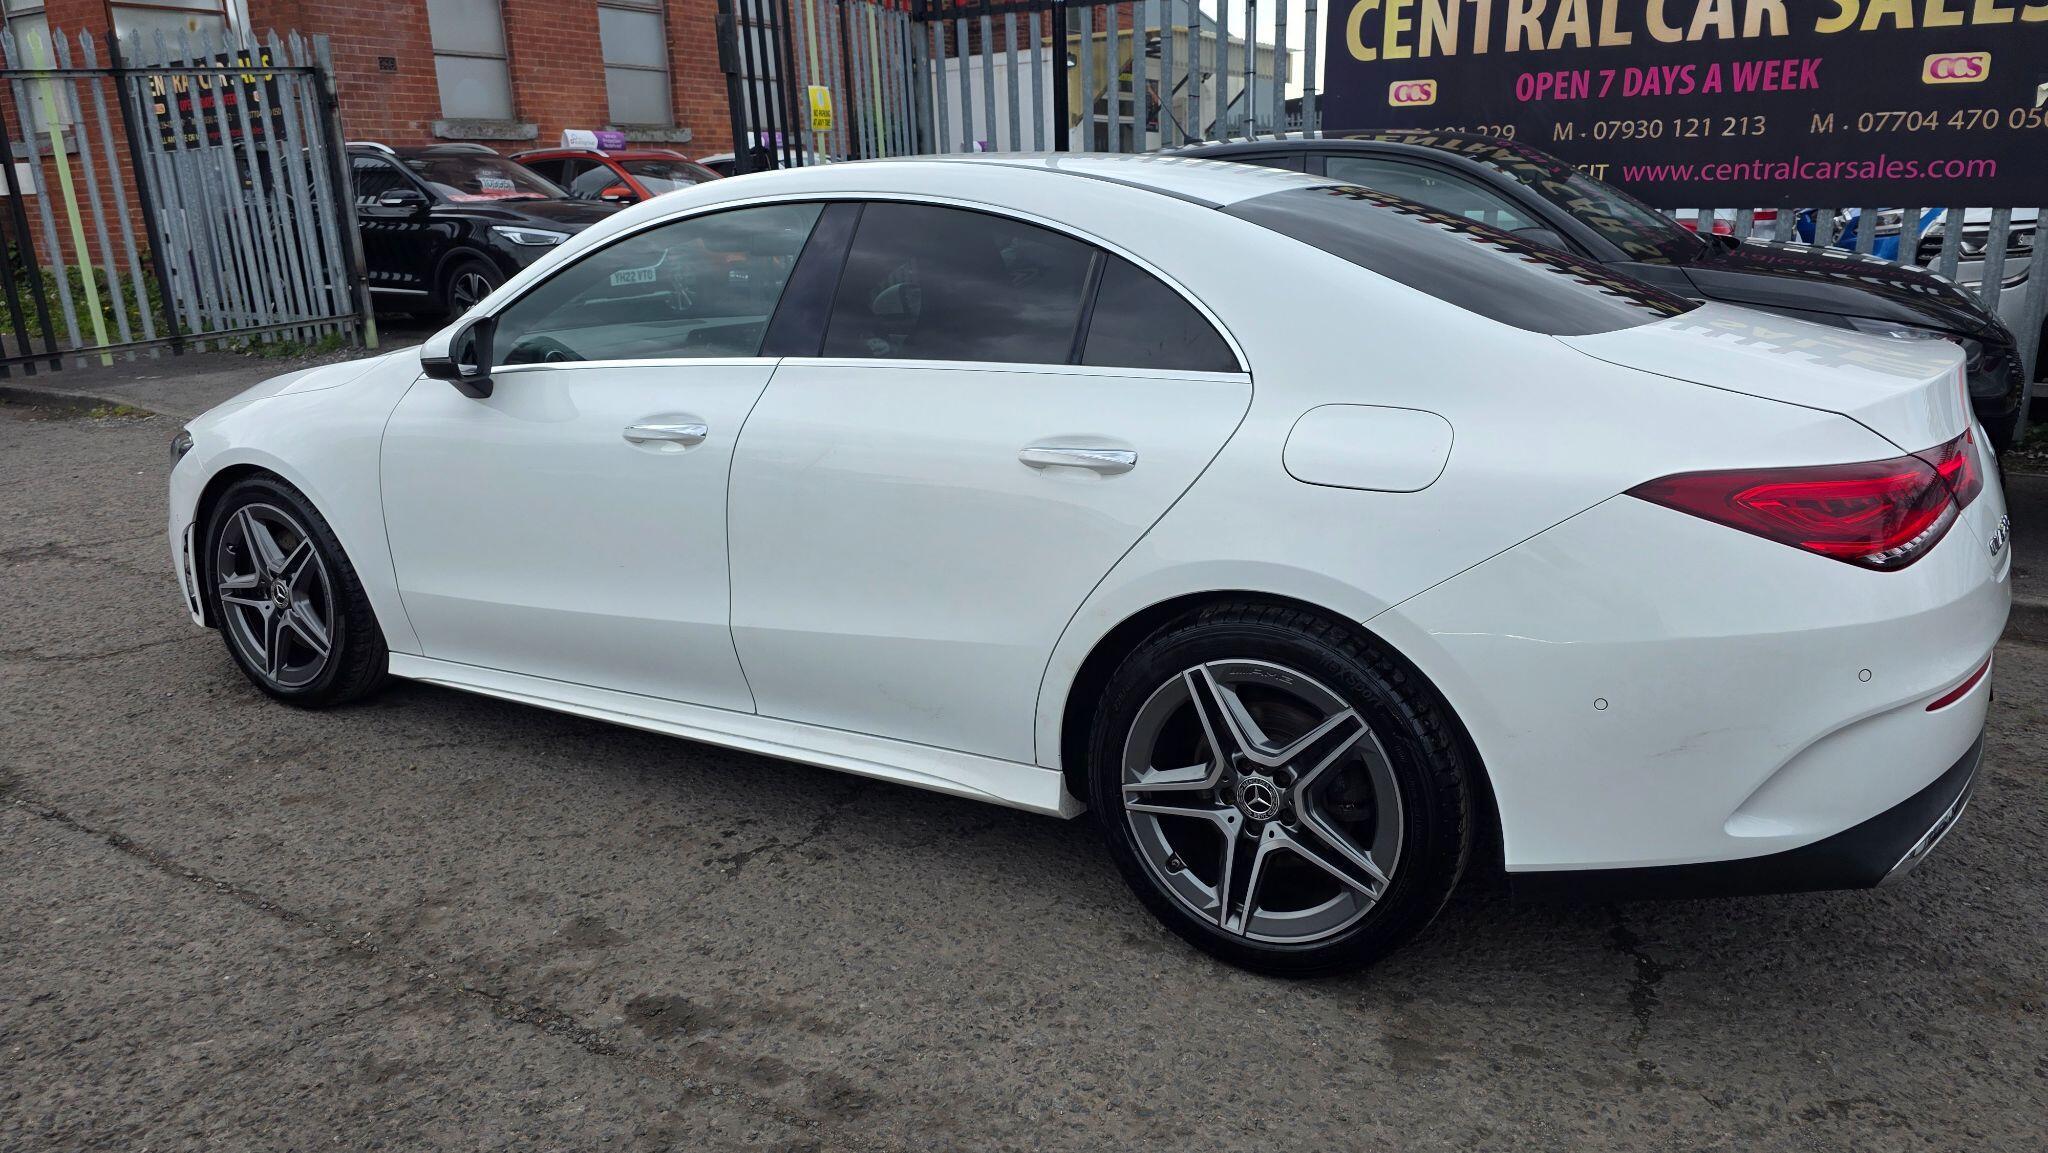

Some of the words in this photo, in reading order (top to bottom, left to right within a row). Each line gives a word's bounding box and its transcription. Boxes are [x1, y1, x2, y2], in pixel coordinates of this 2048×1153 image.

[1345, 0, 1633, 62] CENTRAL
[1515, 69, 1591, 102] OPEN
[1599, 69, 1616, 98] 7
[1622, 63, 1696, 97] DAYS
[1701, 63, 1723, 94] A
[1732, 58, 1823, 93] WEEK
[1929, 56, 1984, 79] CCS
[1394, 83, 1432, 103] CCS
[1553, 121, 1573, 142] M
[1593, 119, 1664, 141] 07930
[1673, 117, 1712, 139] 121
[1721, 115, 1767, 137] 213
[1810, 112, 1835, 134] M
[1857, 110, 1940, 133] 07704
[1947, 108, 2001, 130] 470
[1623, 155, 1998, 182] www.centralcarsales.com
